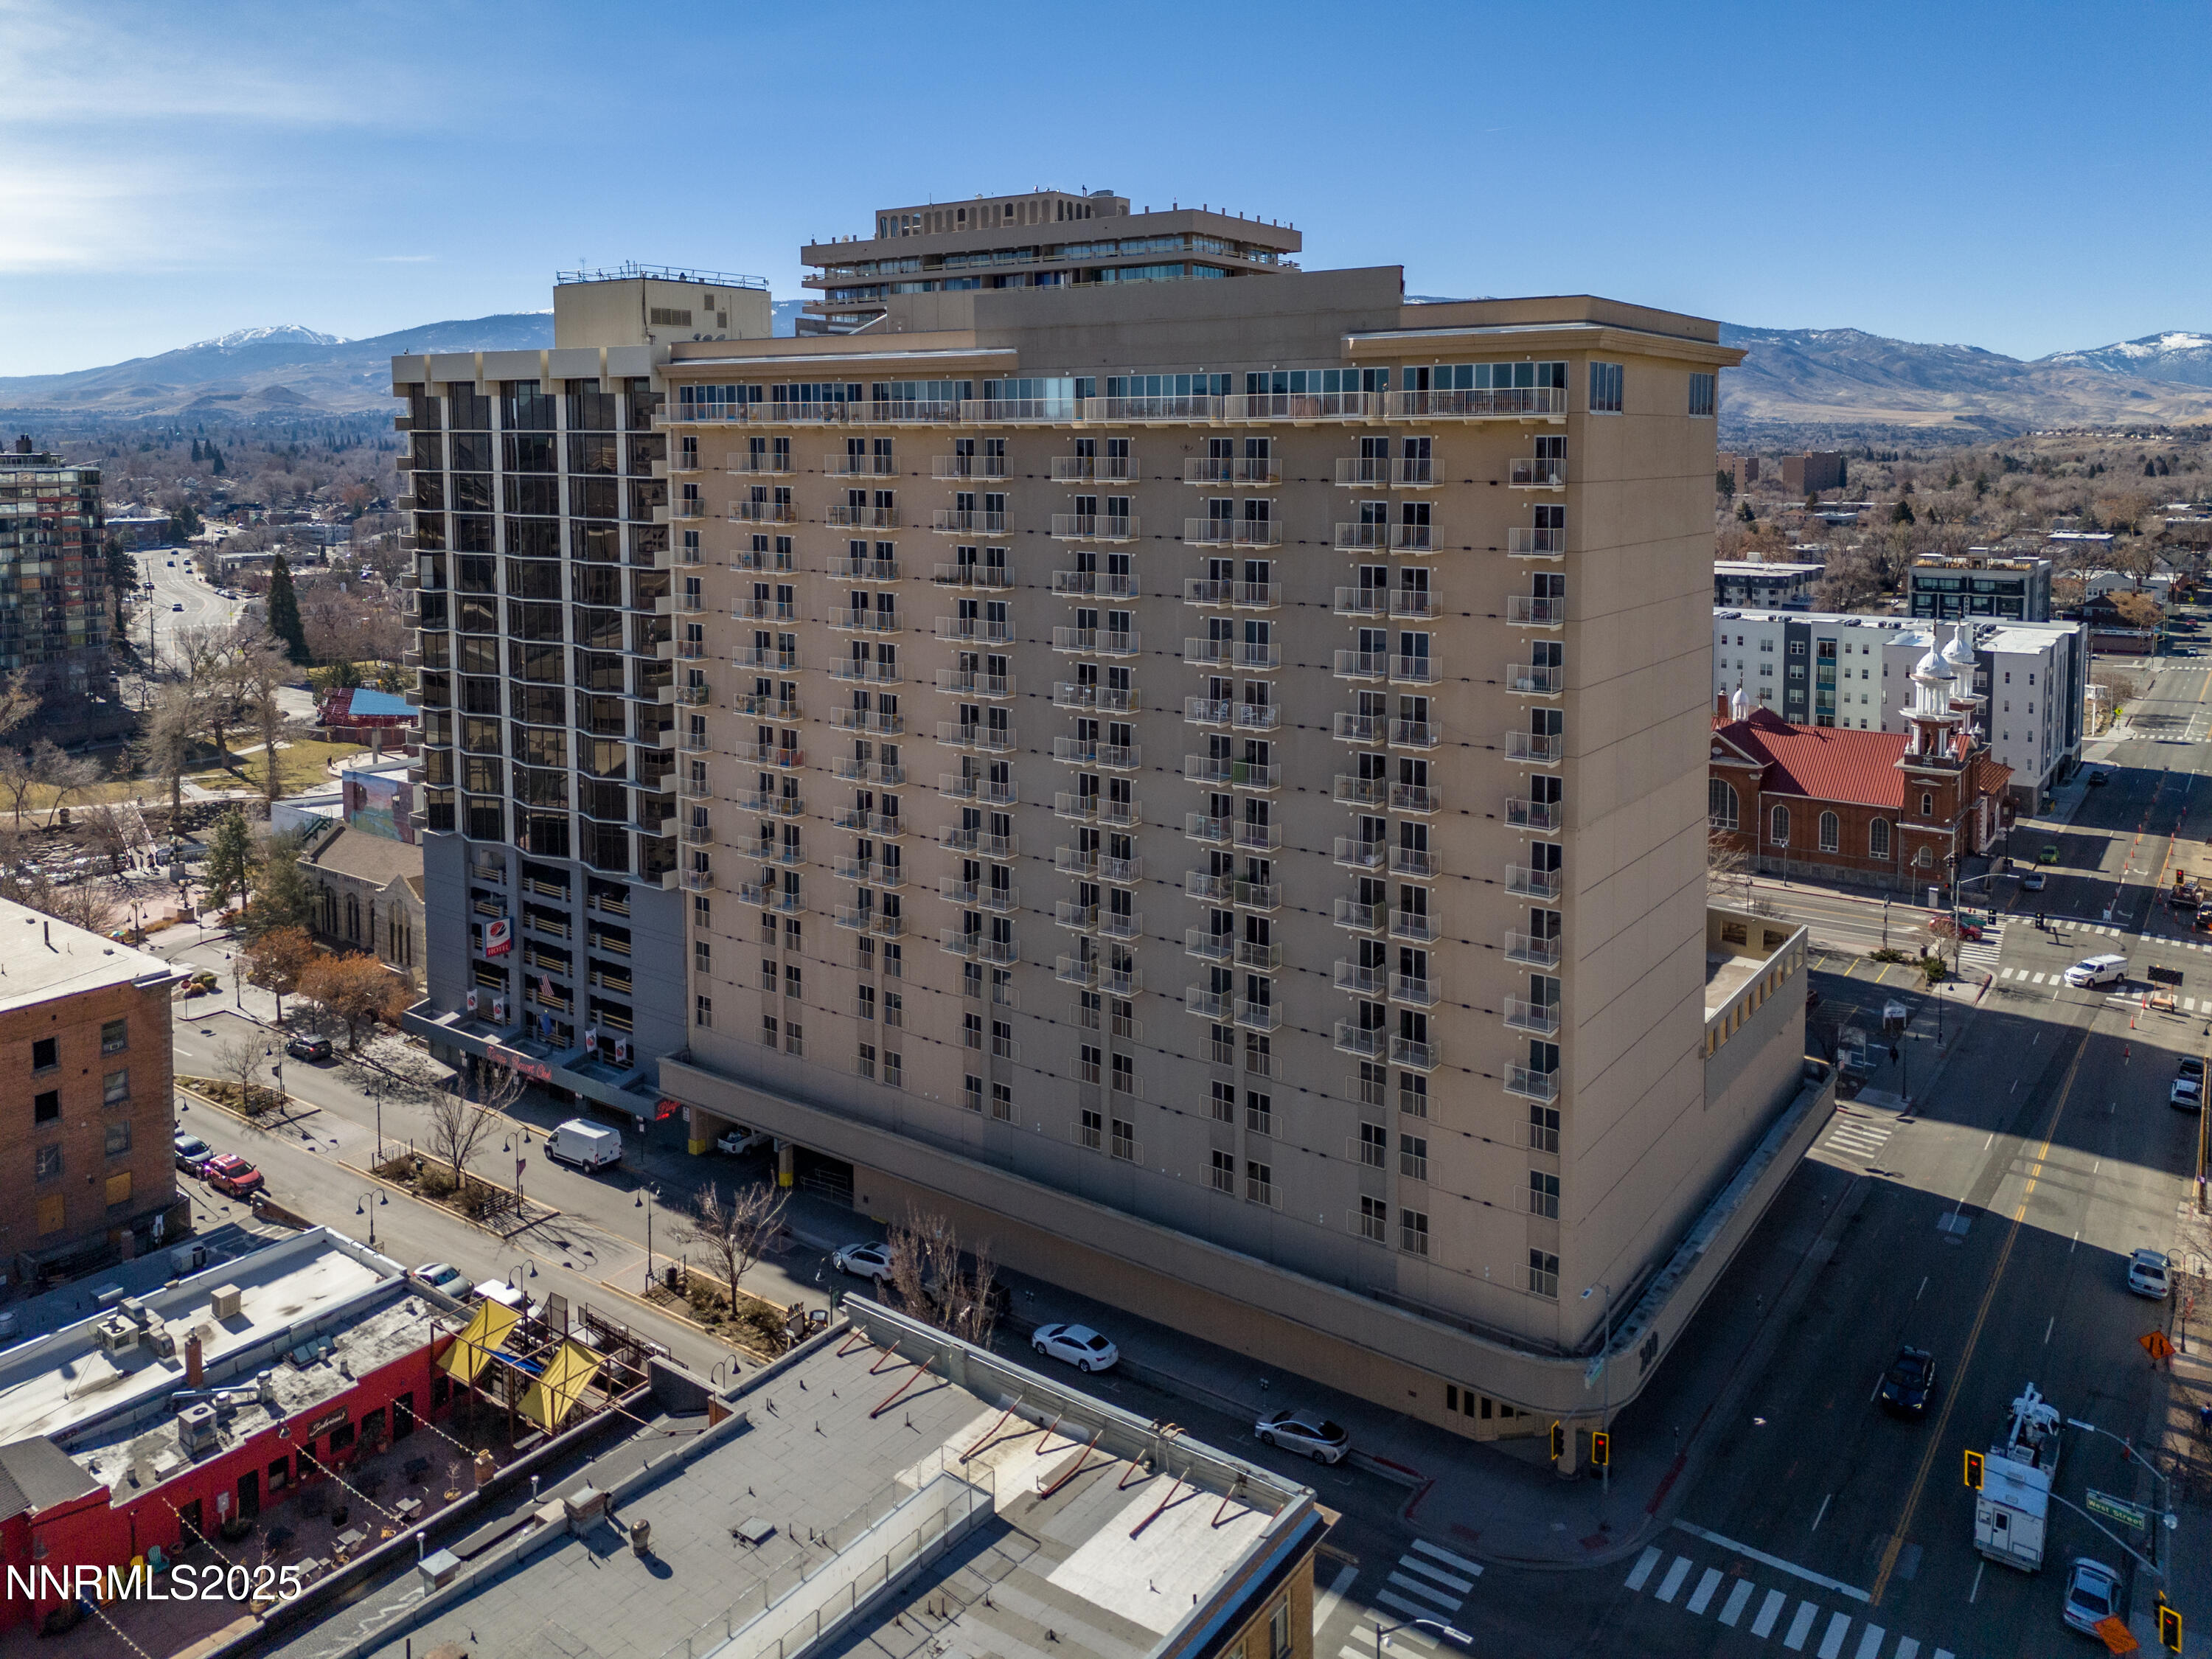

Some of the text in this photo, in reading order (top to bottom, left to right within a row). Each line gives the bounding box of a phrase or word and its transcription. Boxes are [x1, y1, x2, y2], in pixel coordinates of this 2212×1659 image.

[488, 945, 509, 955] HOTEL
[2088, 1499, 2142, 1526] West Street
